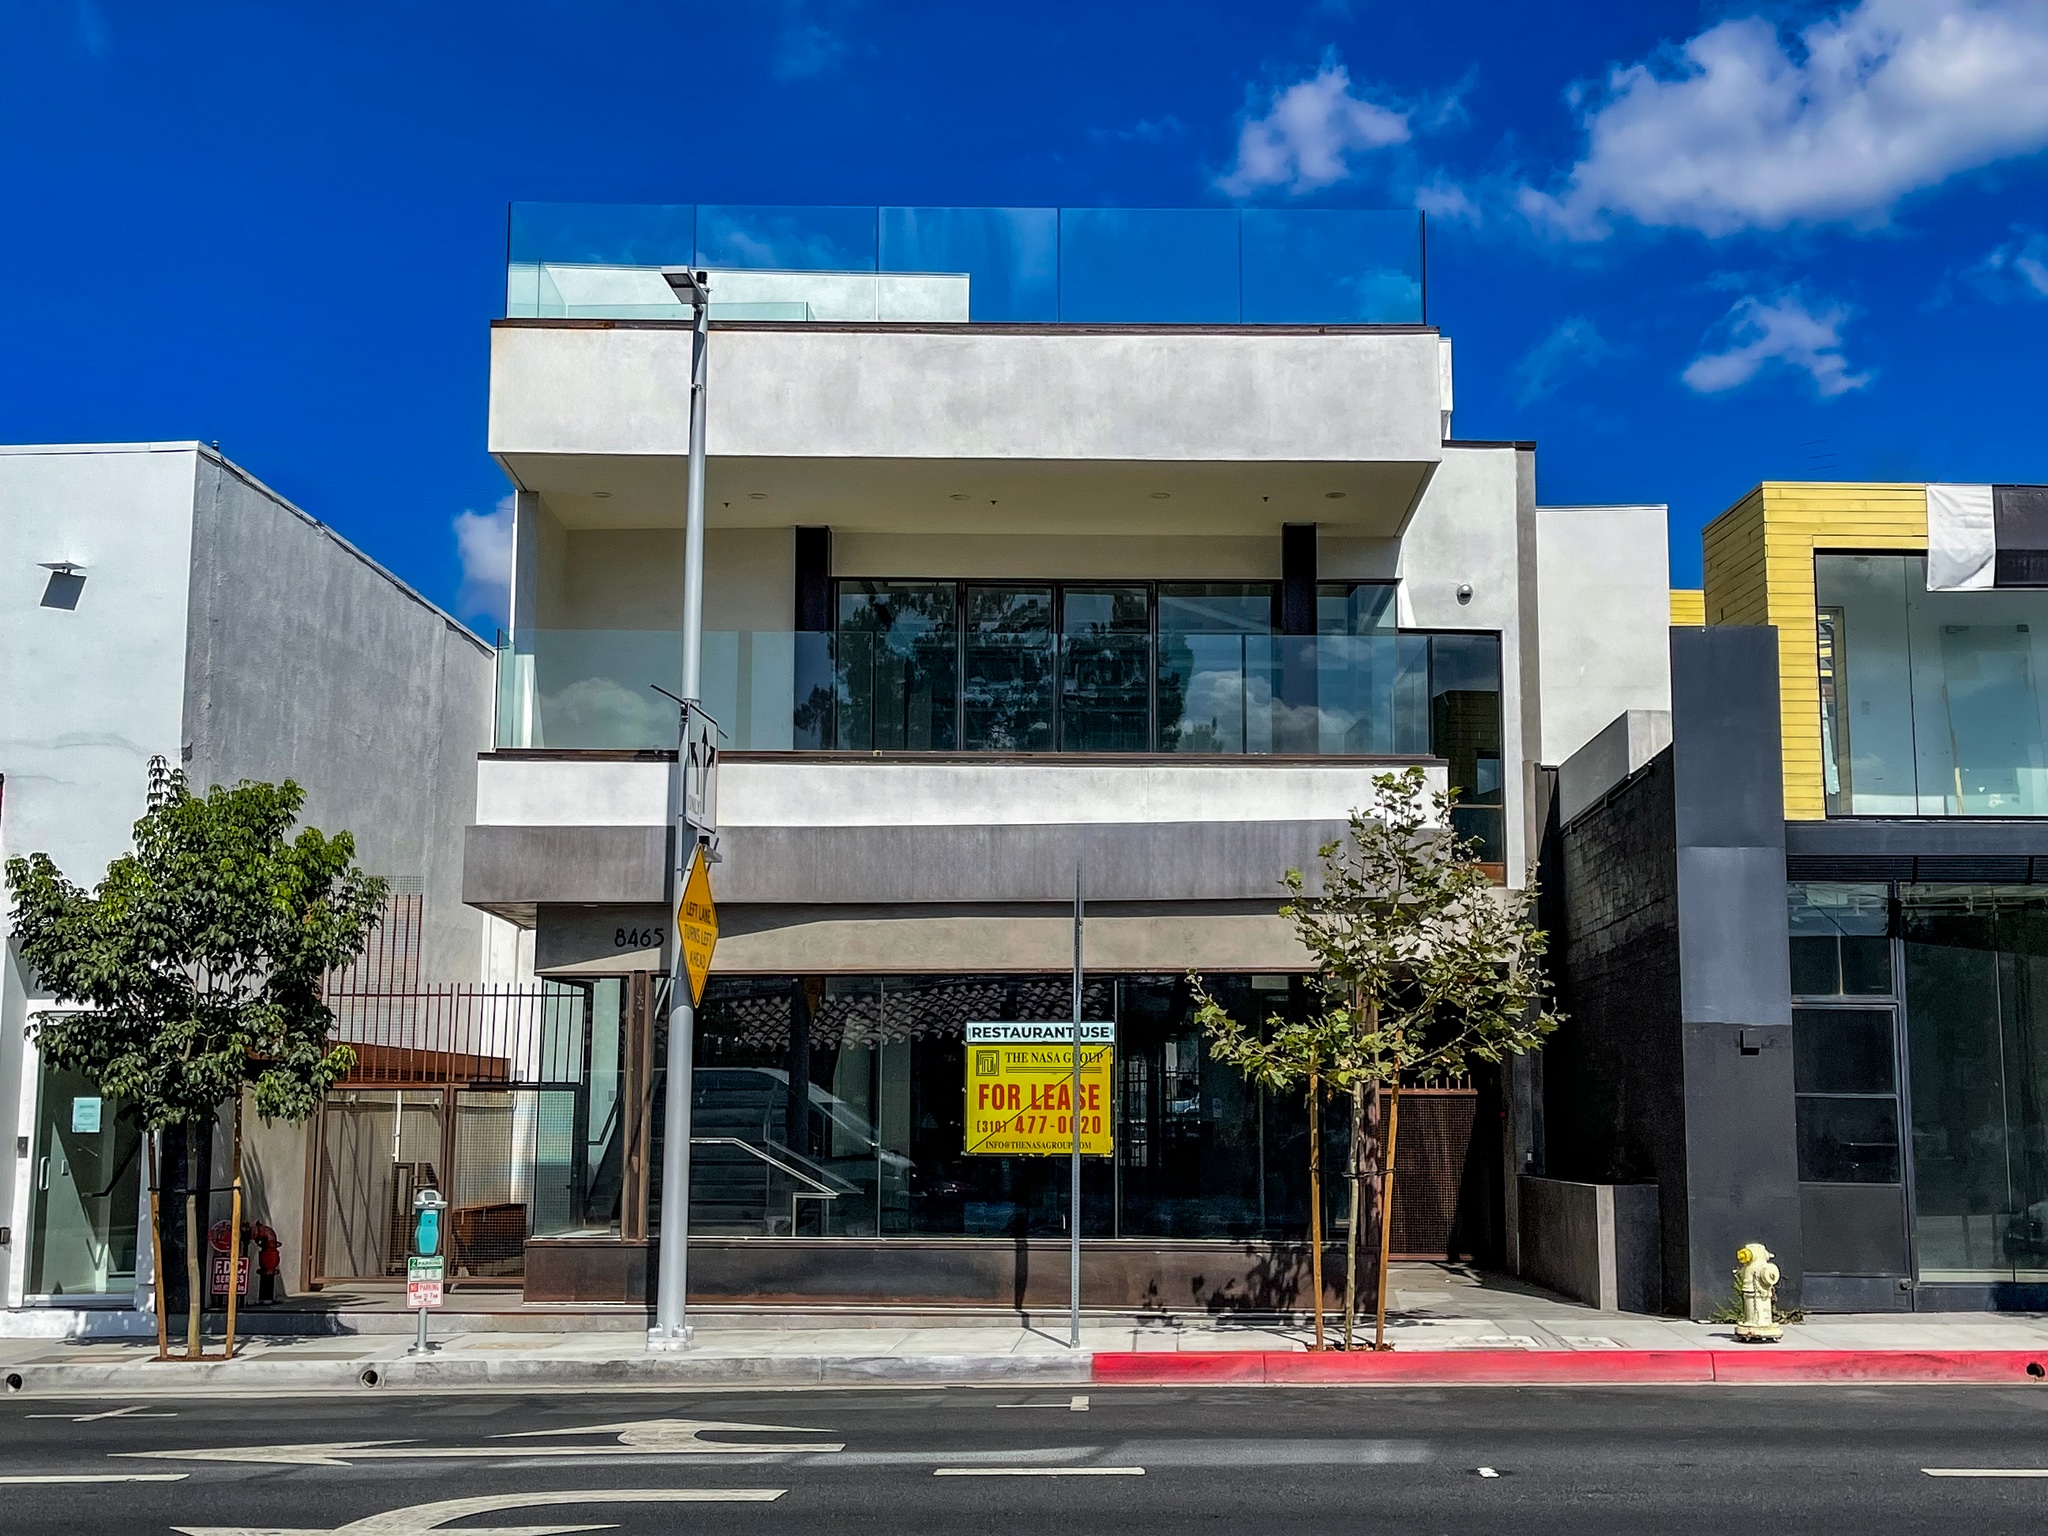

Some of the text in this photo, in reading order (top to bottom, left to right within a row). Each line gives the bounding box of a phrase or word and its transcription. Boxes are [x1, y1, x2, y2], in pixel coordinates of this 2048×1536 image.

[686, 900, 711, 925] LEFT LANE
[614, 928, 665, 948] 8465
[684, 923, 712, 948] TURNS LEFT
[689, 950, 706, 970] AHEAD
[972, 1026, 1110, 1039] RESTAURANT USE
[1005, 1052, 1103, 1063] THE NASA GOUP
[978, 1084, 1021, 1111] FOR
[985, 1140, 1092, 1150] INFO@THENASAGROUPOM
[215, 1260, 246, 1274] F.DC.
[215, 1274, 245, 1284] SERES
